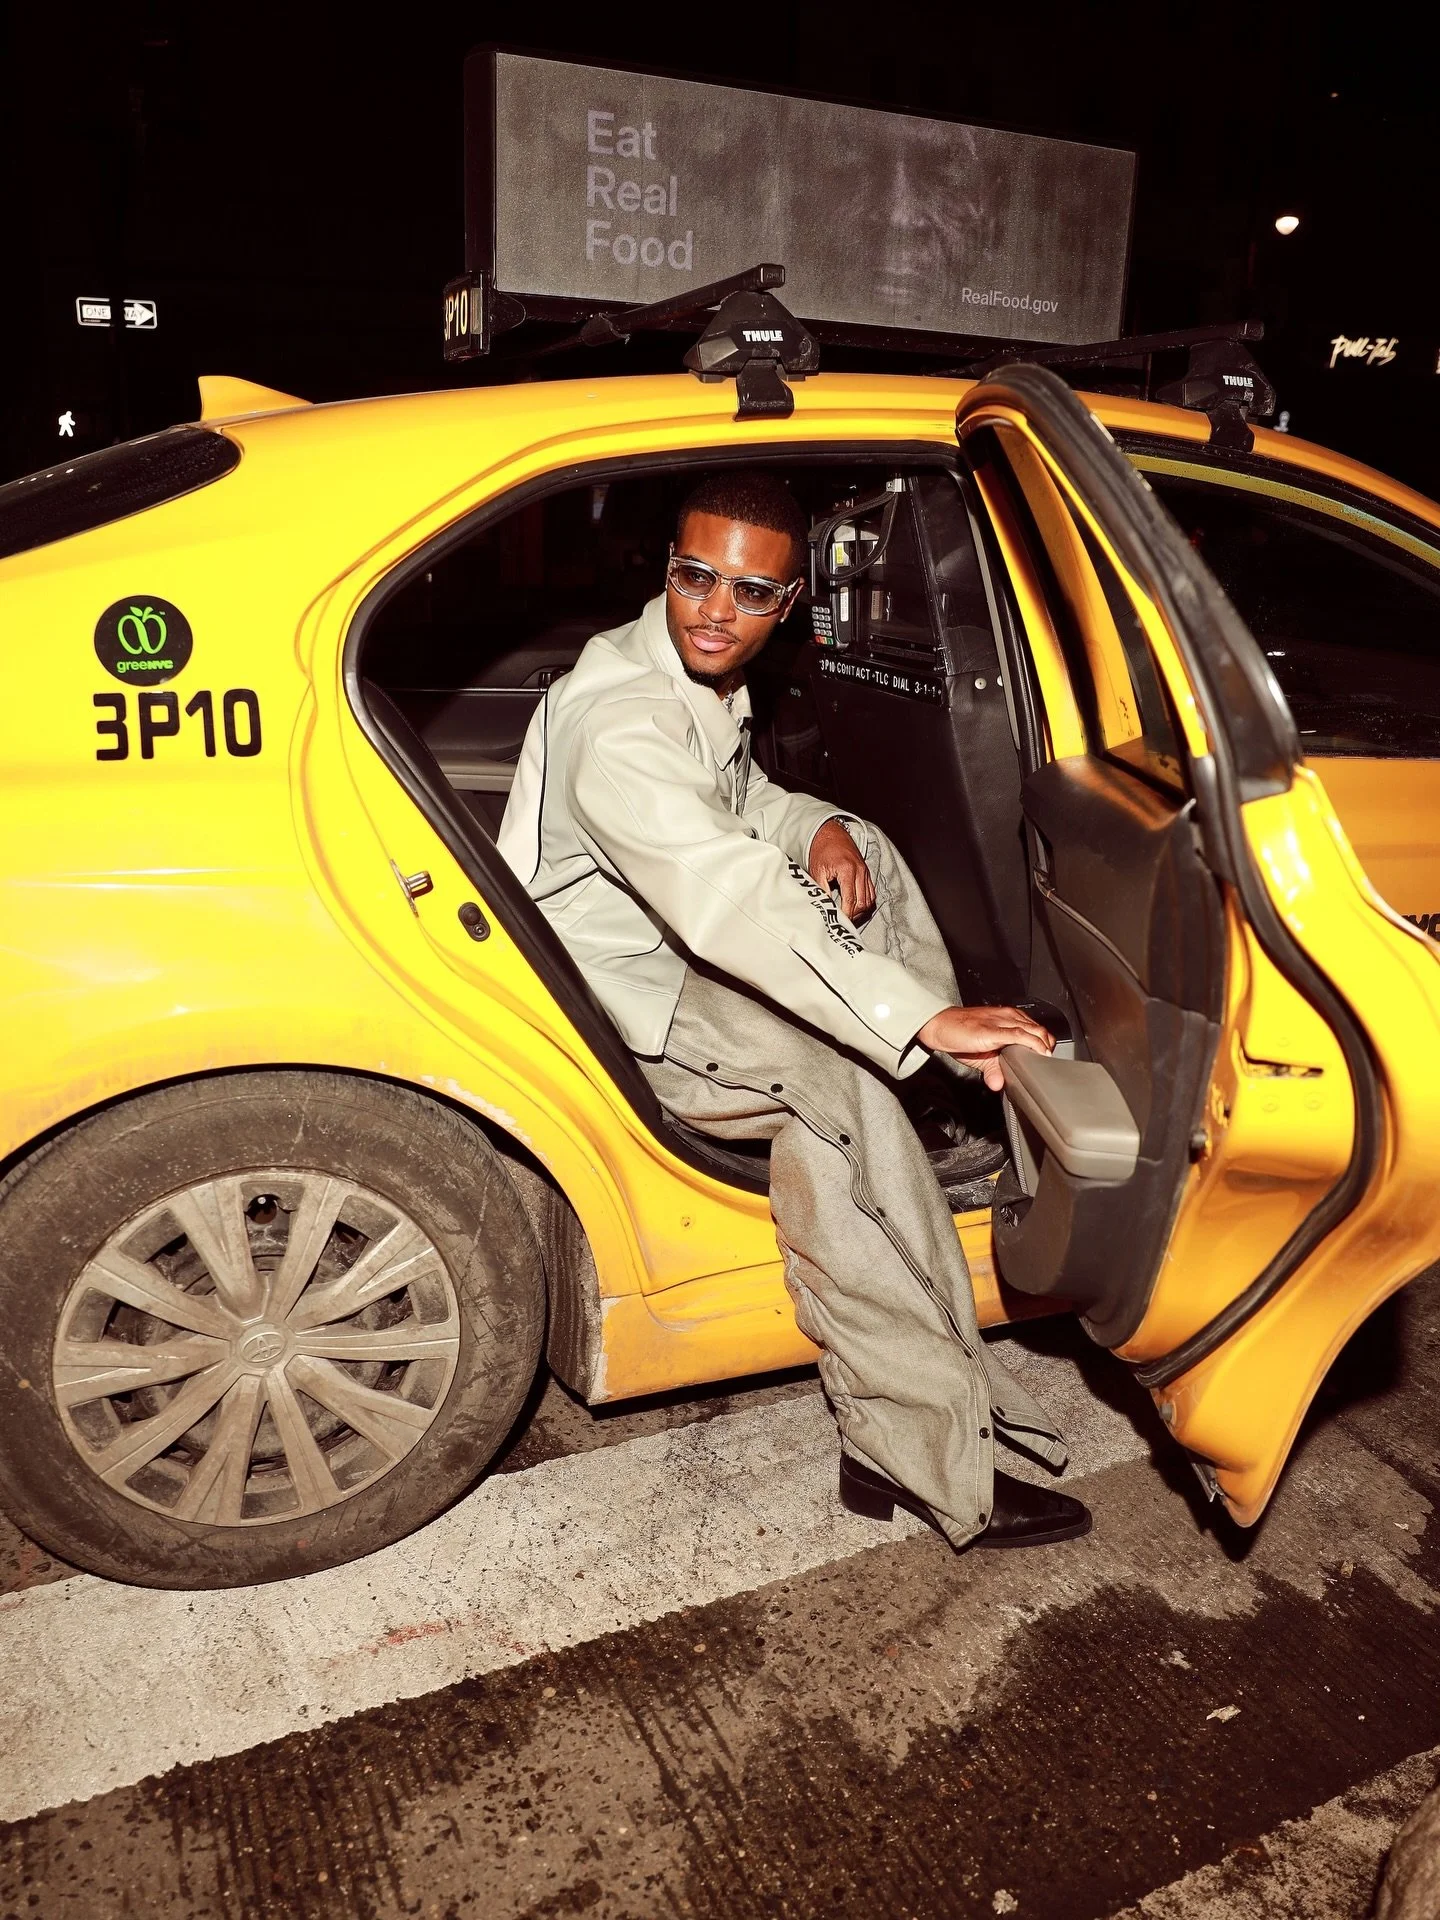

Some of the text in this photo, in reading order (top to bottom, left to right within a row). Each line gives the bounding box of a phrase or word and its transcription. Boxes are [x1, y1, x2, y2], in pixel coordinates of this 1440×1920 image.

[587, 109, 657, 160] Eat
[586, 165, 678, 216] Real
[586, 219, 693, 271] Food
[962, 287, 1059, 314] RealFood.gov
[742, 330, 784, 342] THULE
[1222, 375, 1254, 388] THULE
[836, 661, 871, 681] CONTACT
[874, 670, 889, 686] TLC
[892, 675, 910, 692] DIAL
[93, 688, 262, 761] 3P10
[839, 941, 856, 959] INC.
